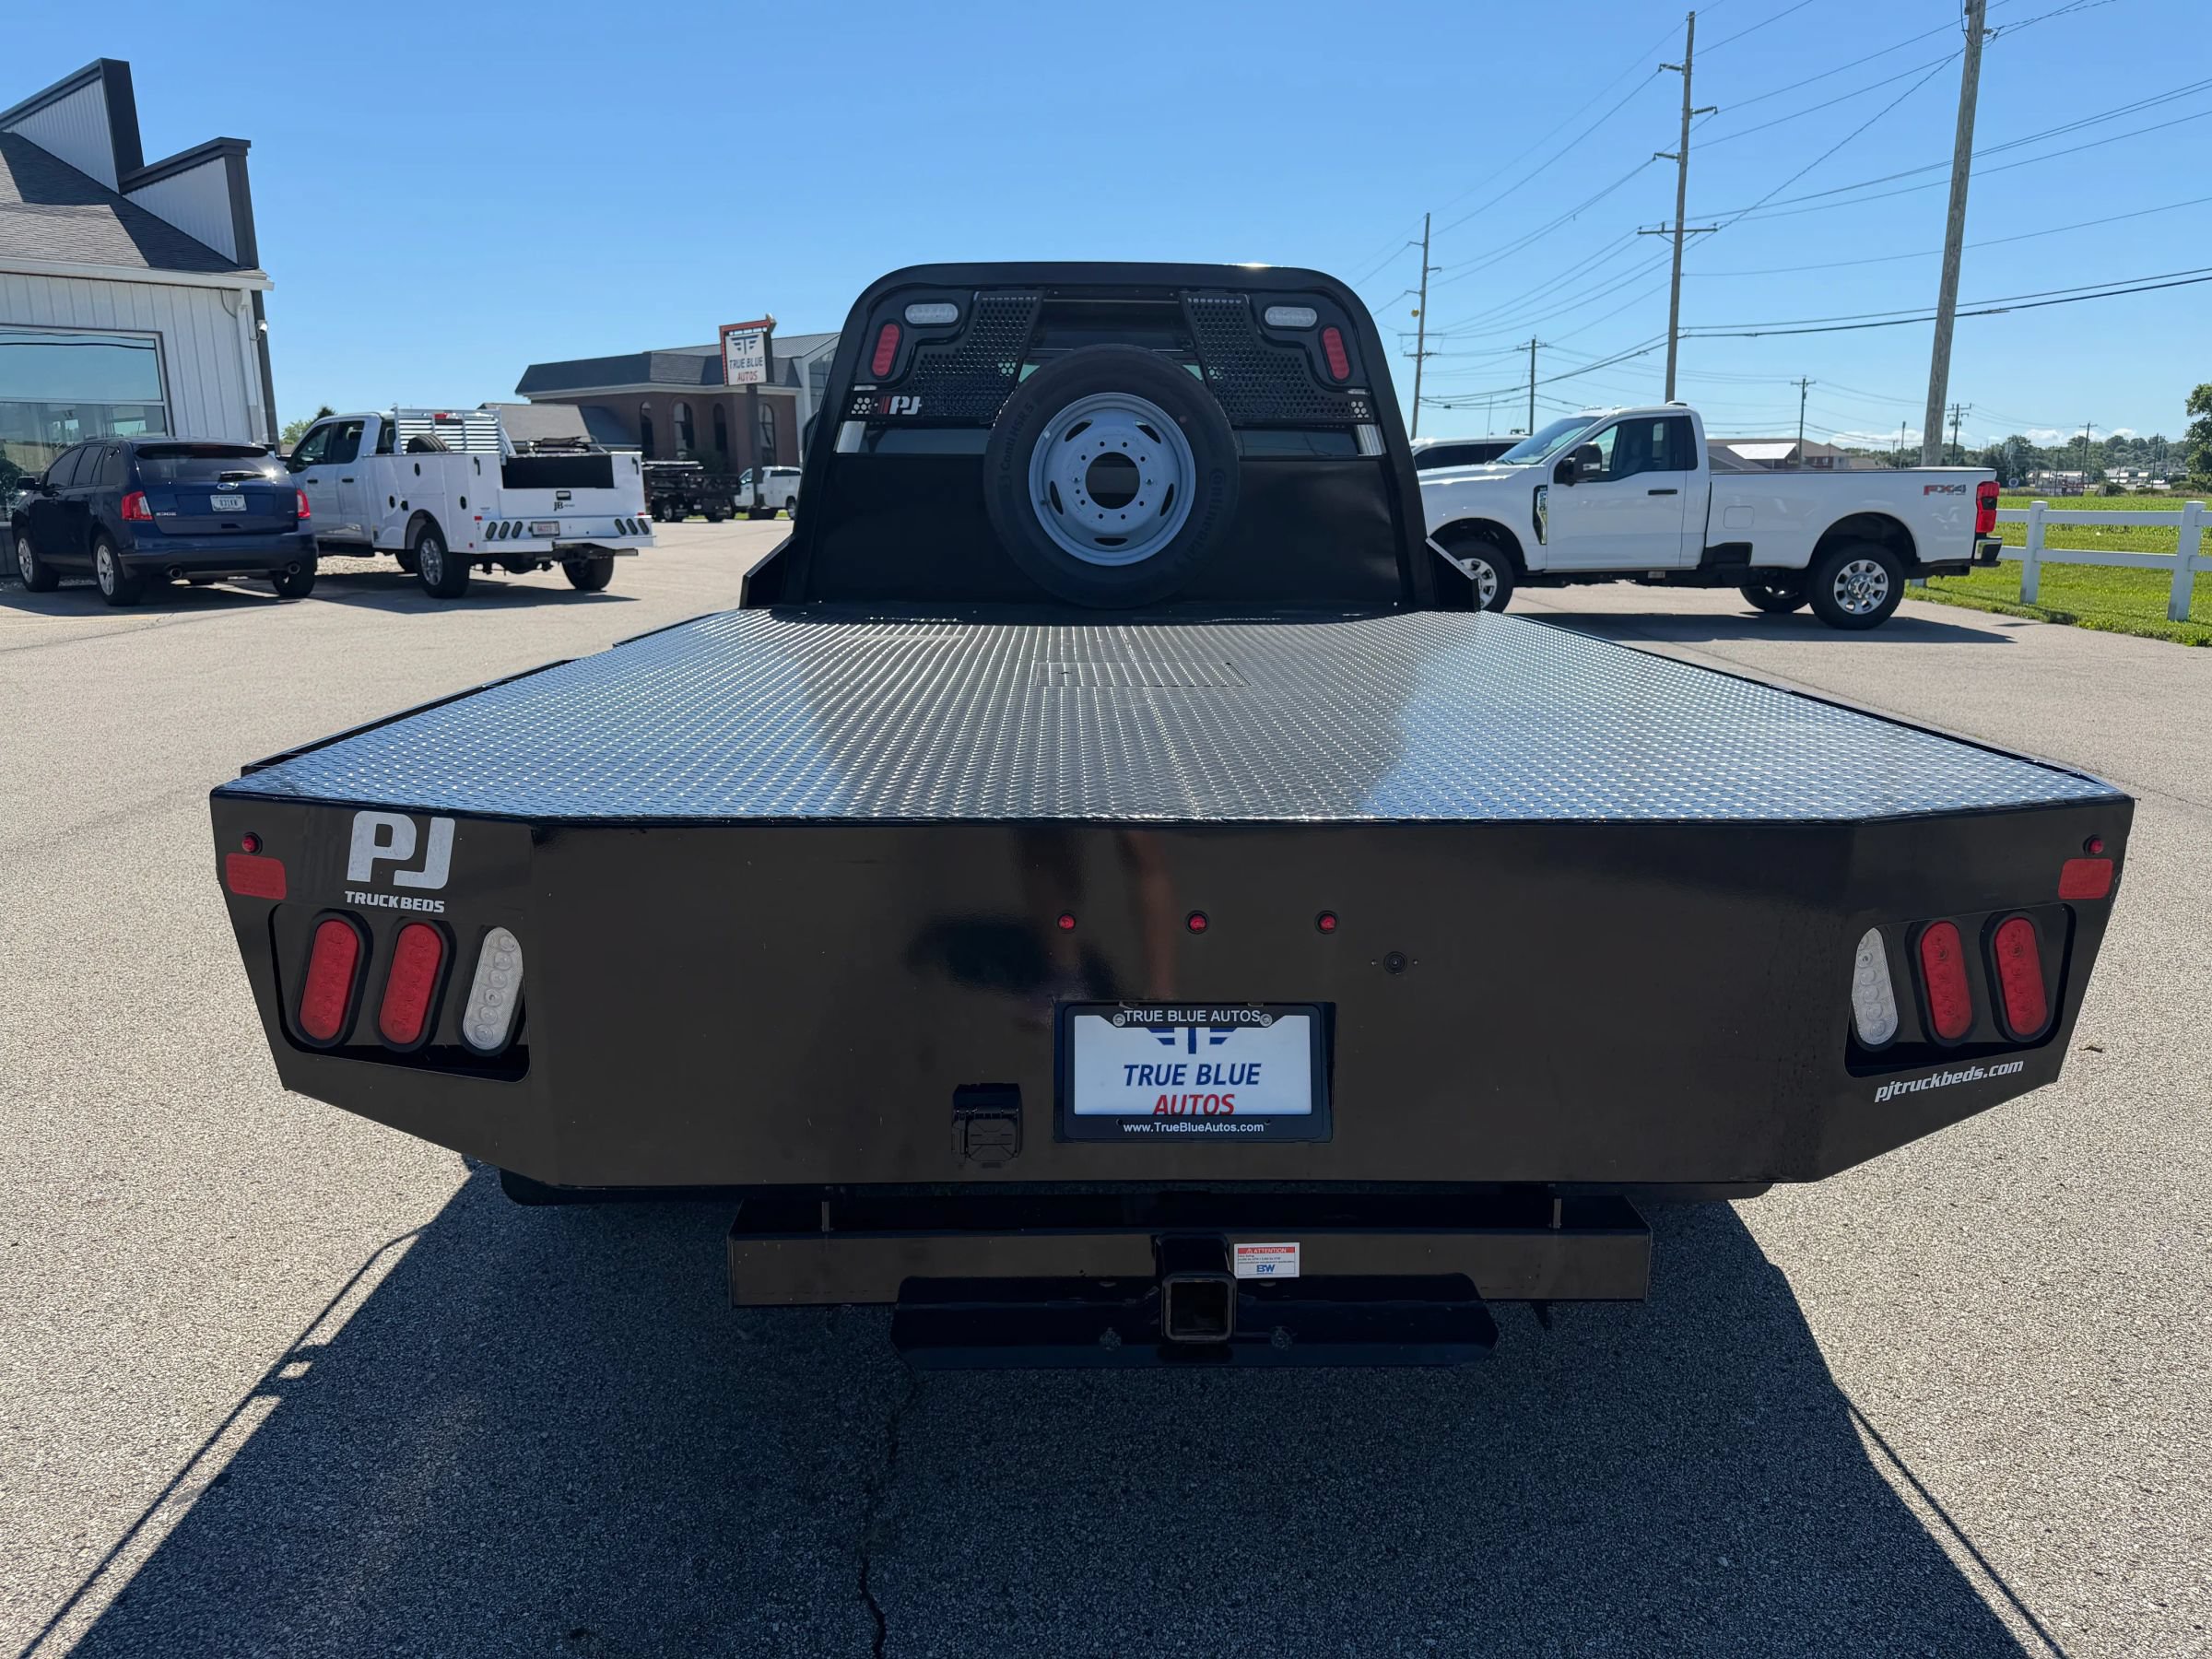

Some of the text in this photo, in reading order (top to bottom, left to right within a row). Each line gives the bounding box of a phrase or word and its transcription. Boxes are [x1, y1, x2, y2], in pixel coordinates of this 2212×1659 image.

[729, 357, 763, 369] TRUE BLUE
[737, 371, 759, 382] AUTOS
[888, 396, 921, 415] PJ
[1924, 484, 1966, 496] FX4
[347, 810, 456, 889] PJ
[1124, 1010, 1261, 1022] TRUE BLUE AUTOS
[1124, 1063, 1262, 1087] TRUE BLUE
[1874, 1060, 2024, 1103] pjtruckbeds.com
[1153, 1094, 1236, 1115] AUTOS
[1124, 1122, 1265, 1133] www.TrueBlueAutos.com
